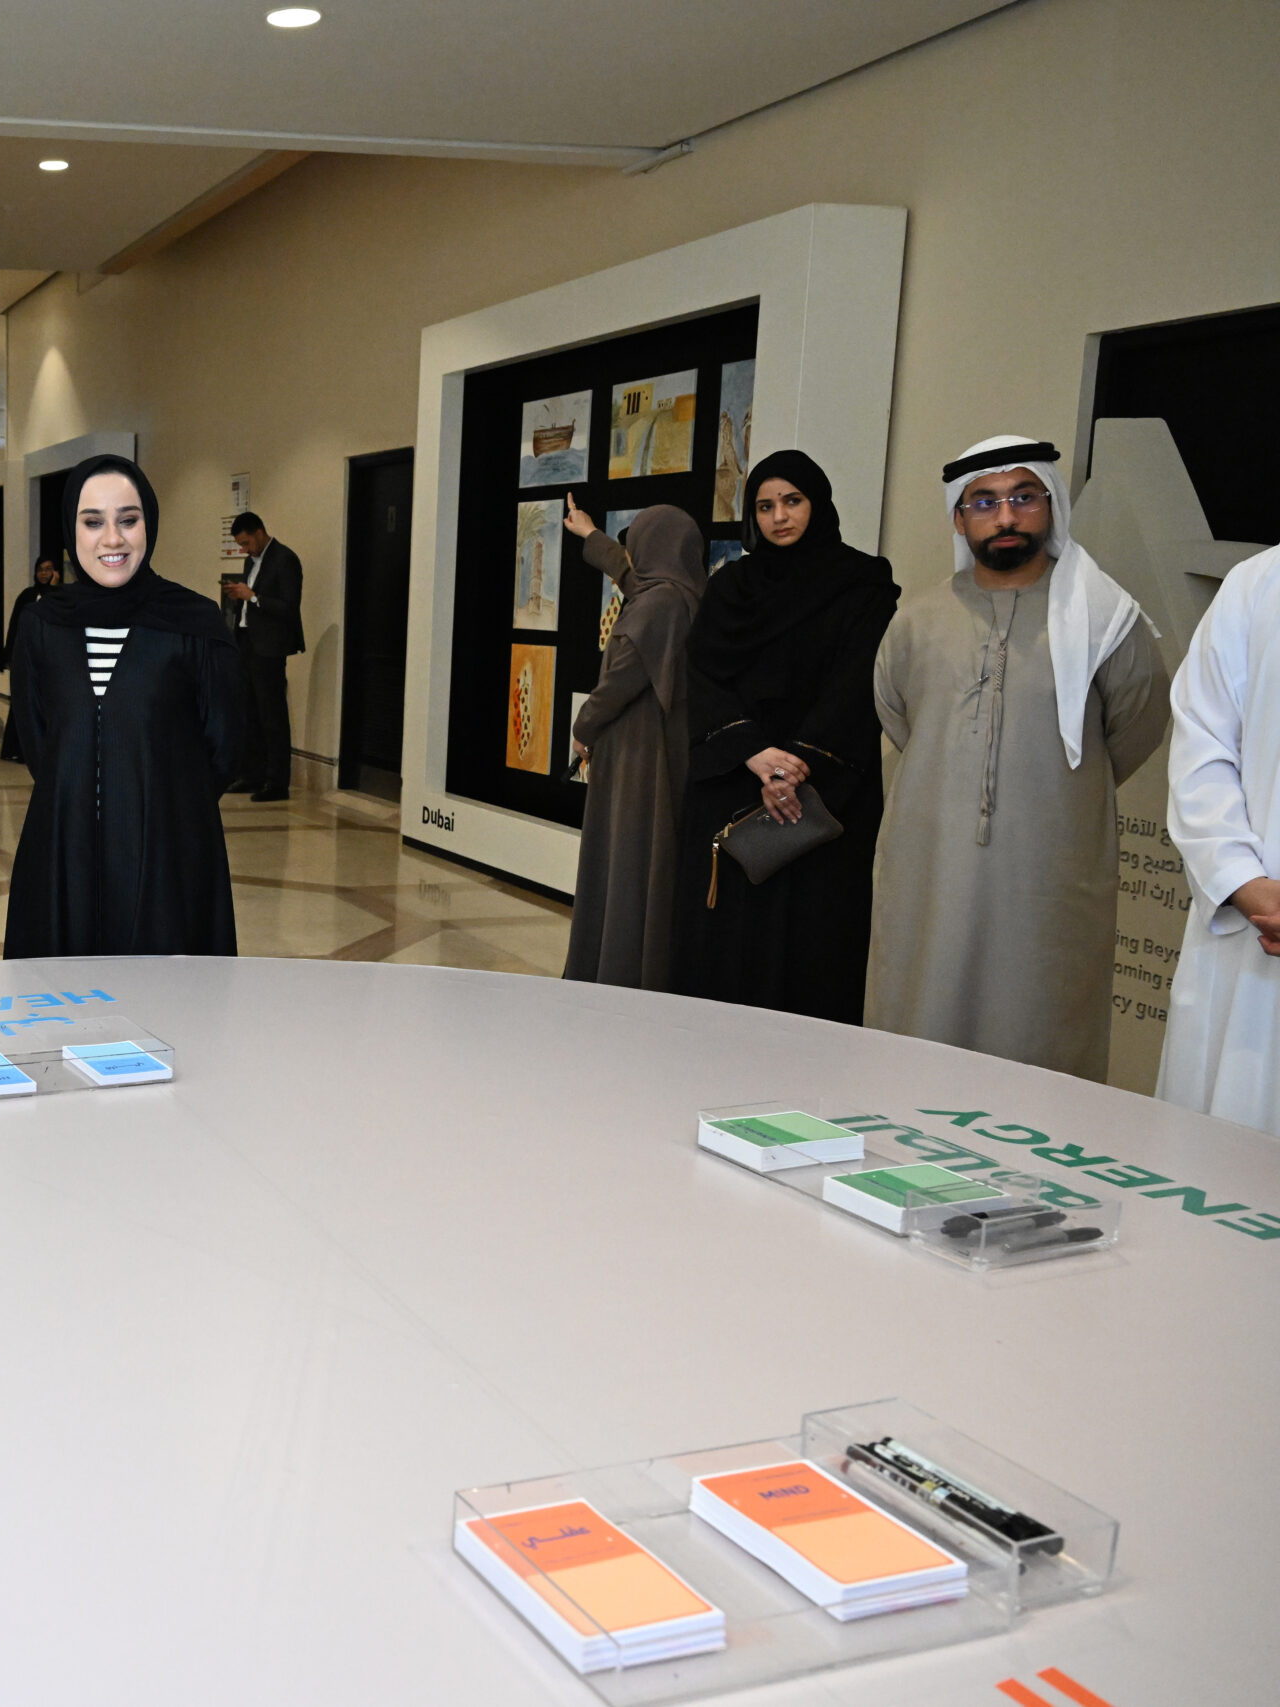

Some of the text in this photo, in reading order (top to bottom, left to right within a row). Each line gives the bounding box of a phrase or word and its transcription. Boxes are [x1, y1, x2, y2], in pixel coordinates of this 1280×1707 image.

[422, 805, 455, 832] Dubai
[1113, 962, 1162, 990] oming
[915, 1108, 1280, 1240] ENERGY
[758, 1484, 810, 1501] MIND
